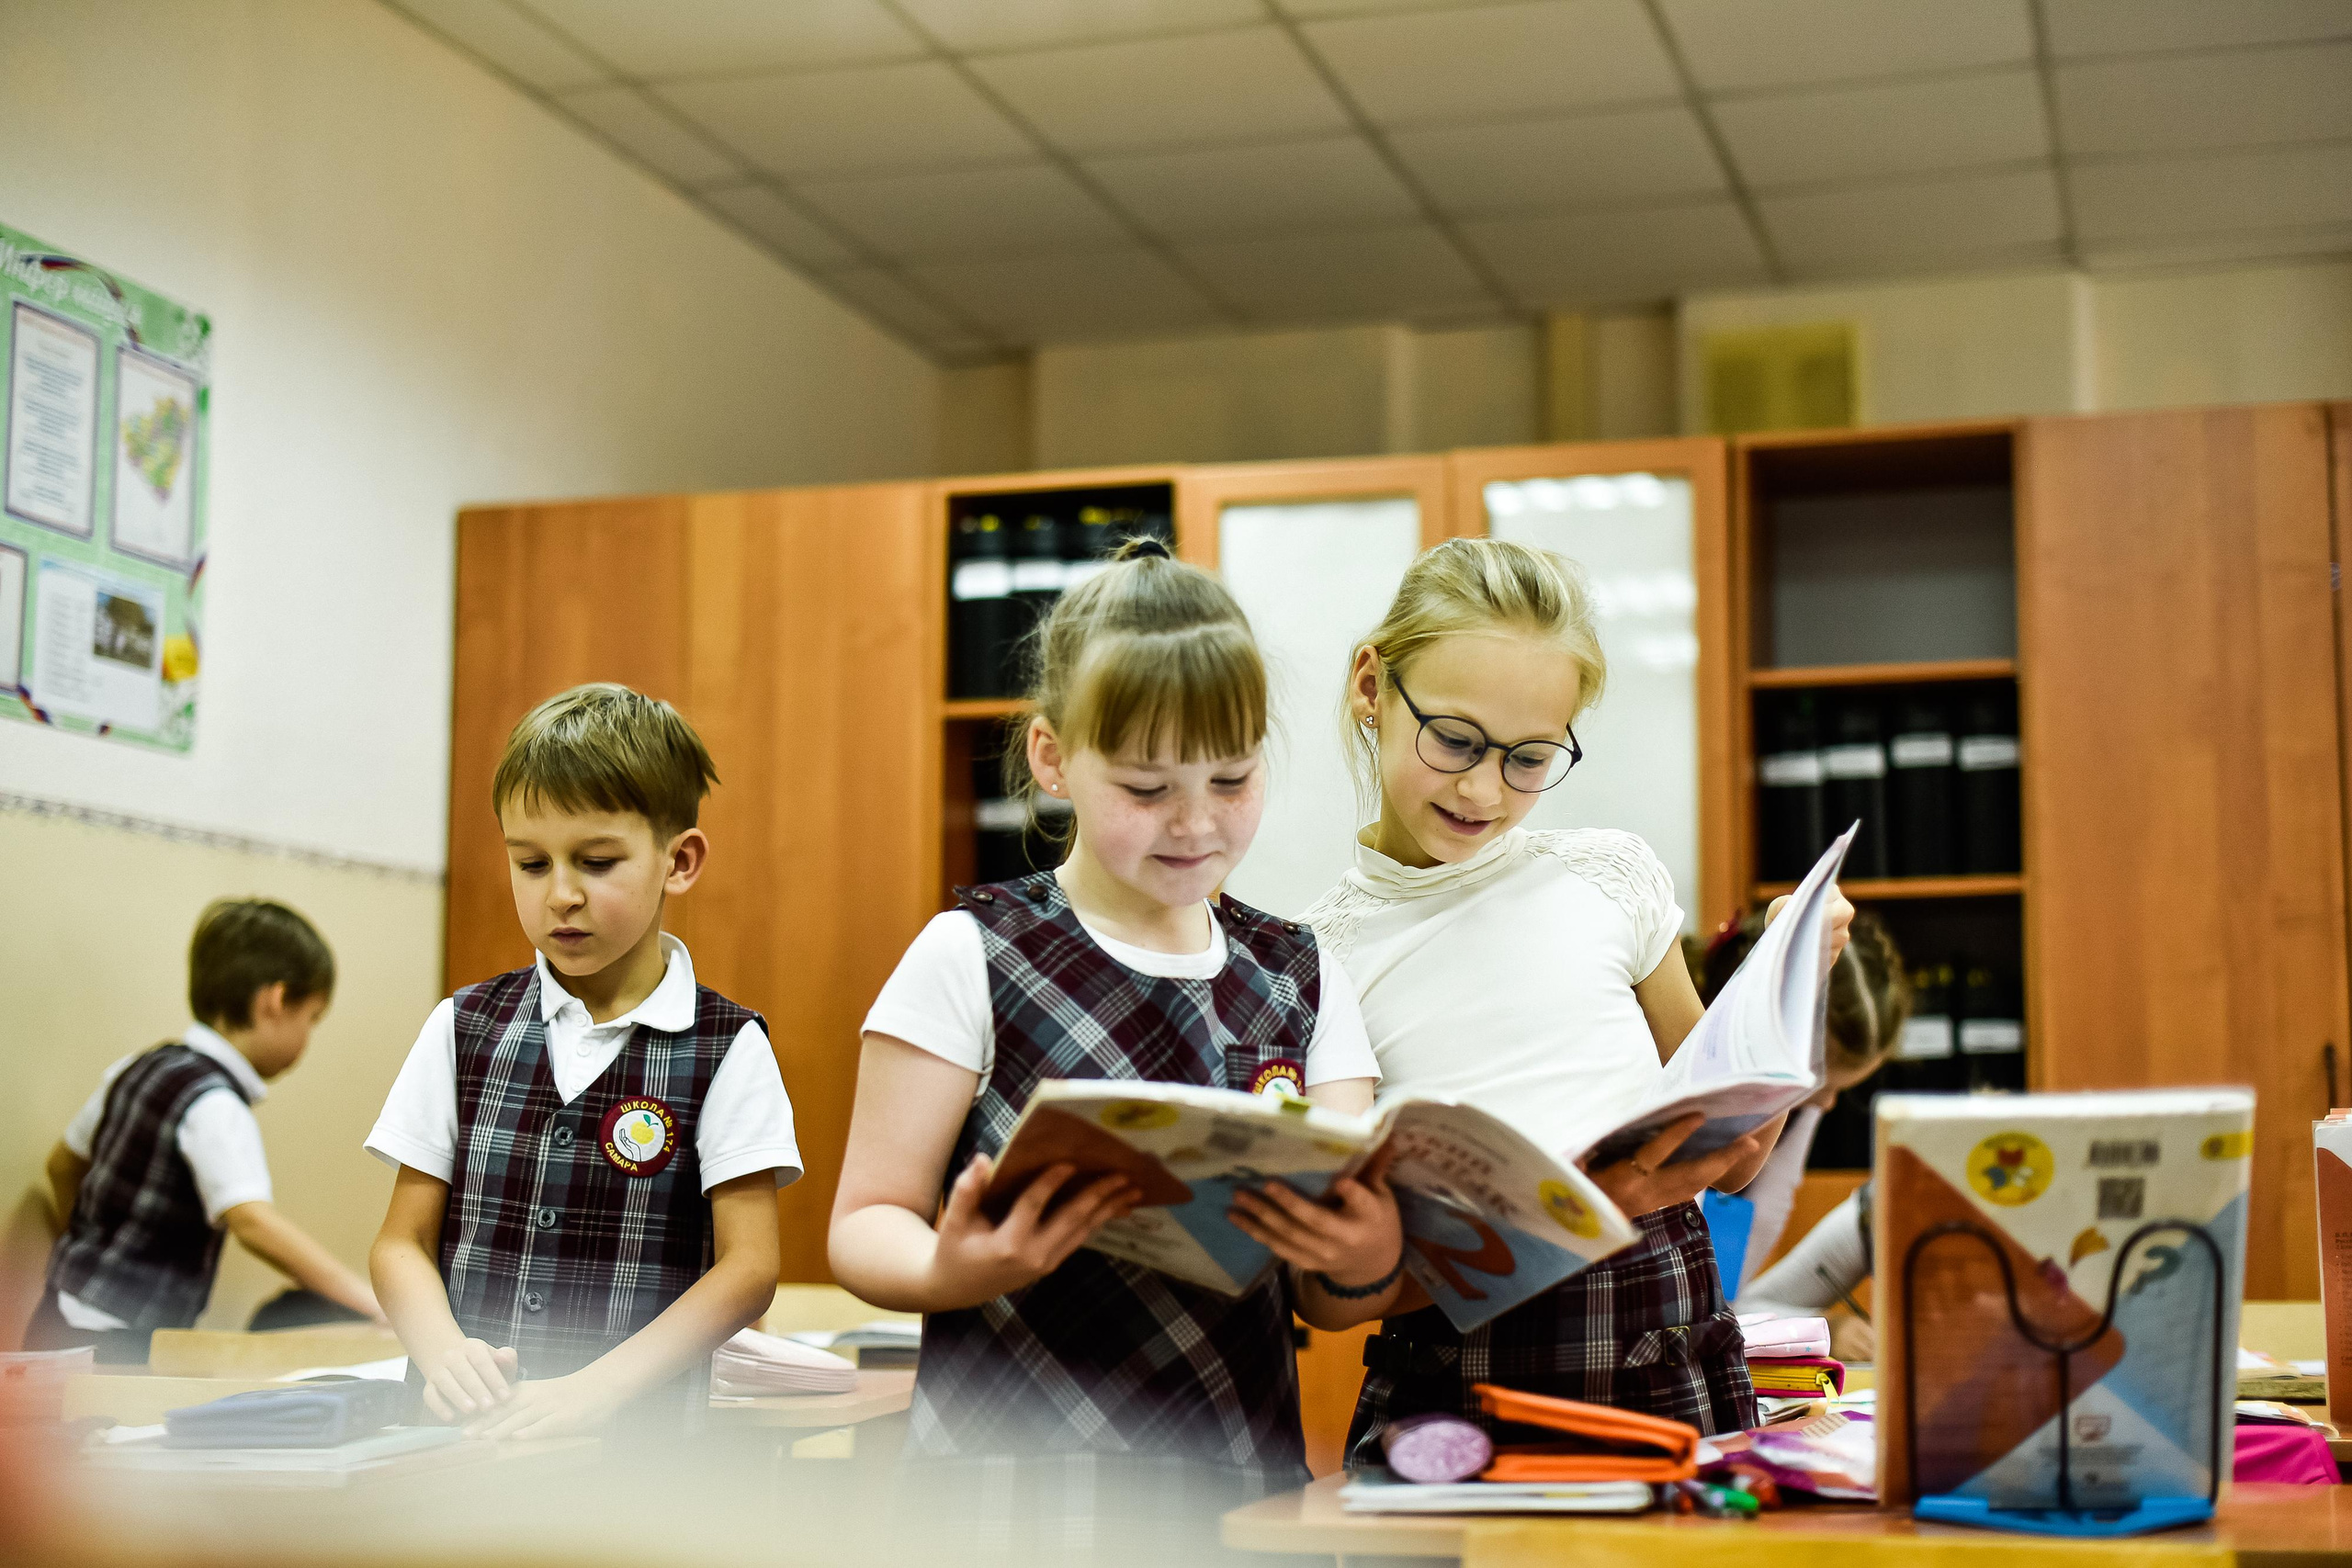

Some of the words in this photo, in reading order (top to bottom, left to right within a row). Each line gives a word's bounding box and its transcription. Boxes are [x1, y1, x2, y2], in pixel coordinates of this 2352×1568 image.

[1252, 1065, 1287, 1095] ШКОЛА
[620, 1100, 664, 1118] ШКОЛА
[663, 1115, 673, 1129] №
[662, 1132, 674, 1153] 174
[605, 1142, 639, 1172] САМАРА
